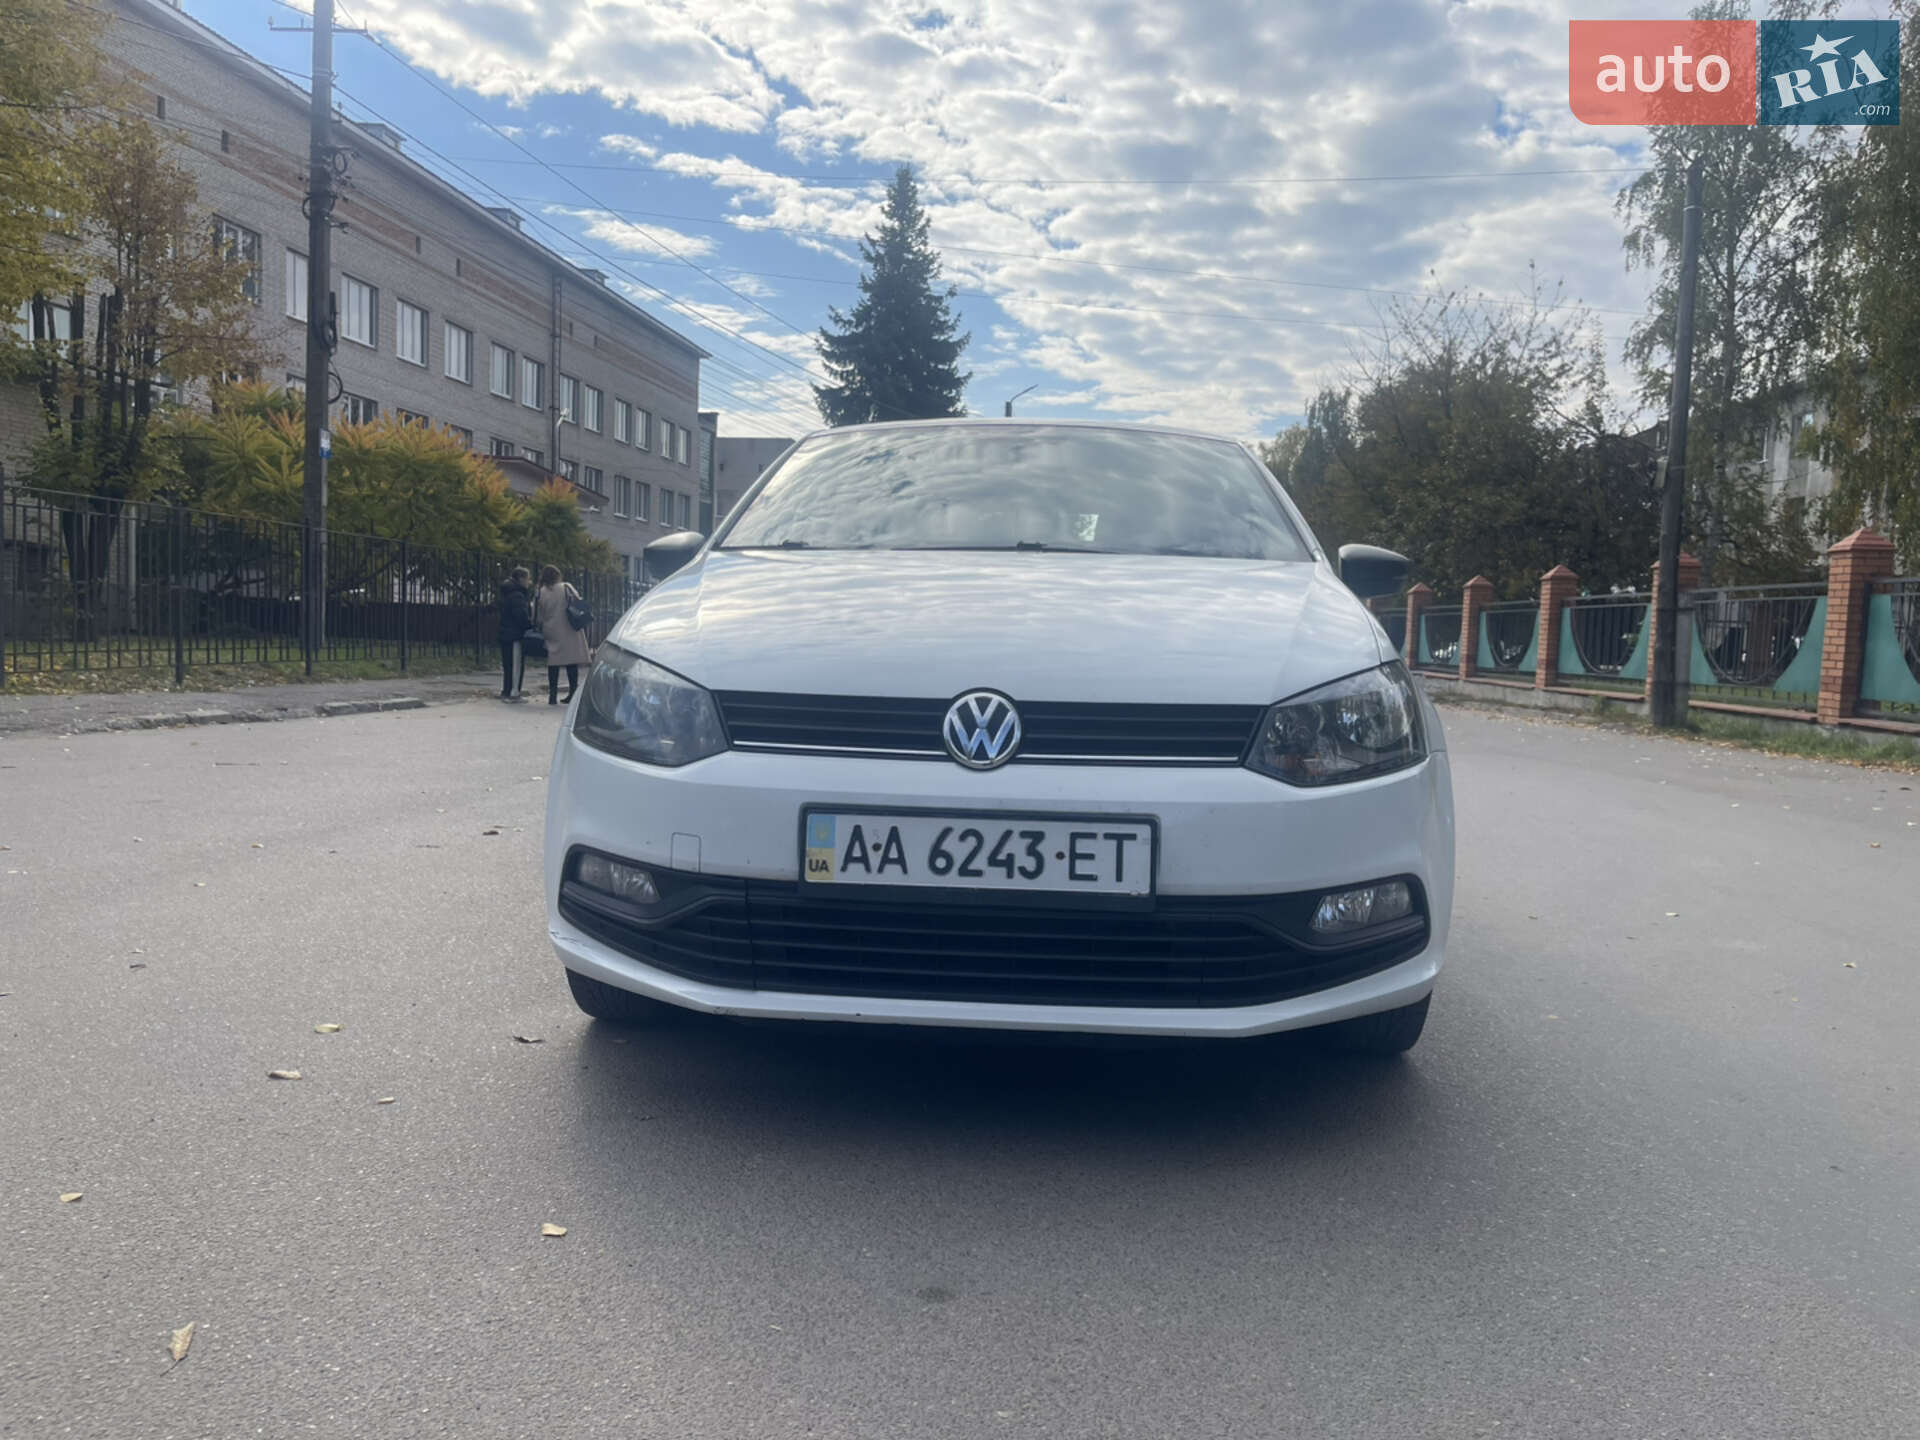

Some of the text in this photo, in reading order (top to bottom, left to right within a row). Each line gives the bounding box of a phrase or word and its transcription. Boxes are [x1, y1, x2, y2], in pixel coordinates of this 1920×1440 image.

[948, 694, 1017, 763] VW
[808, 859, 830, 873] UA
[840, 824, 1138, 883] AA 6243 ET
